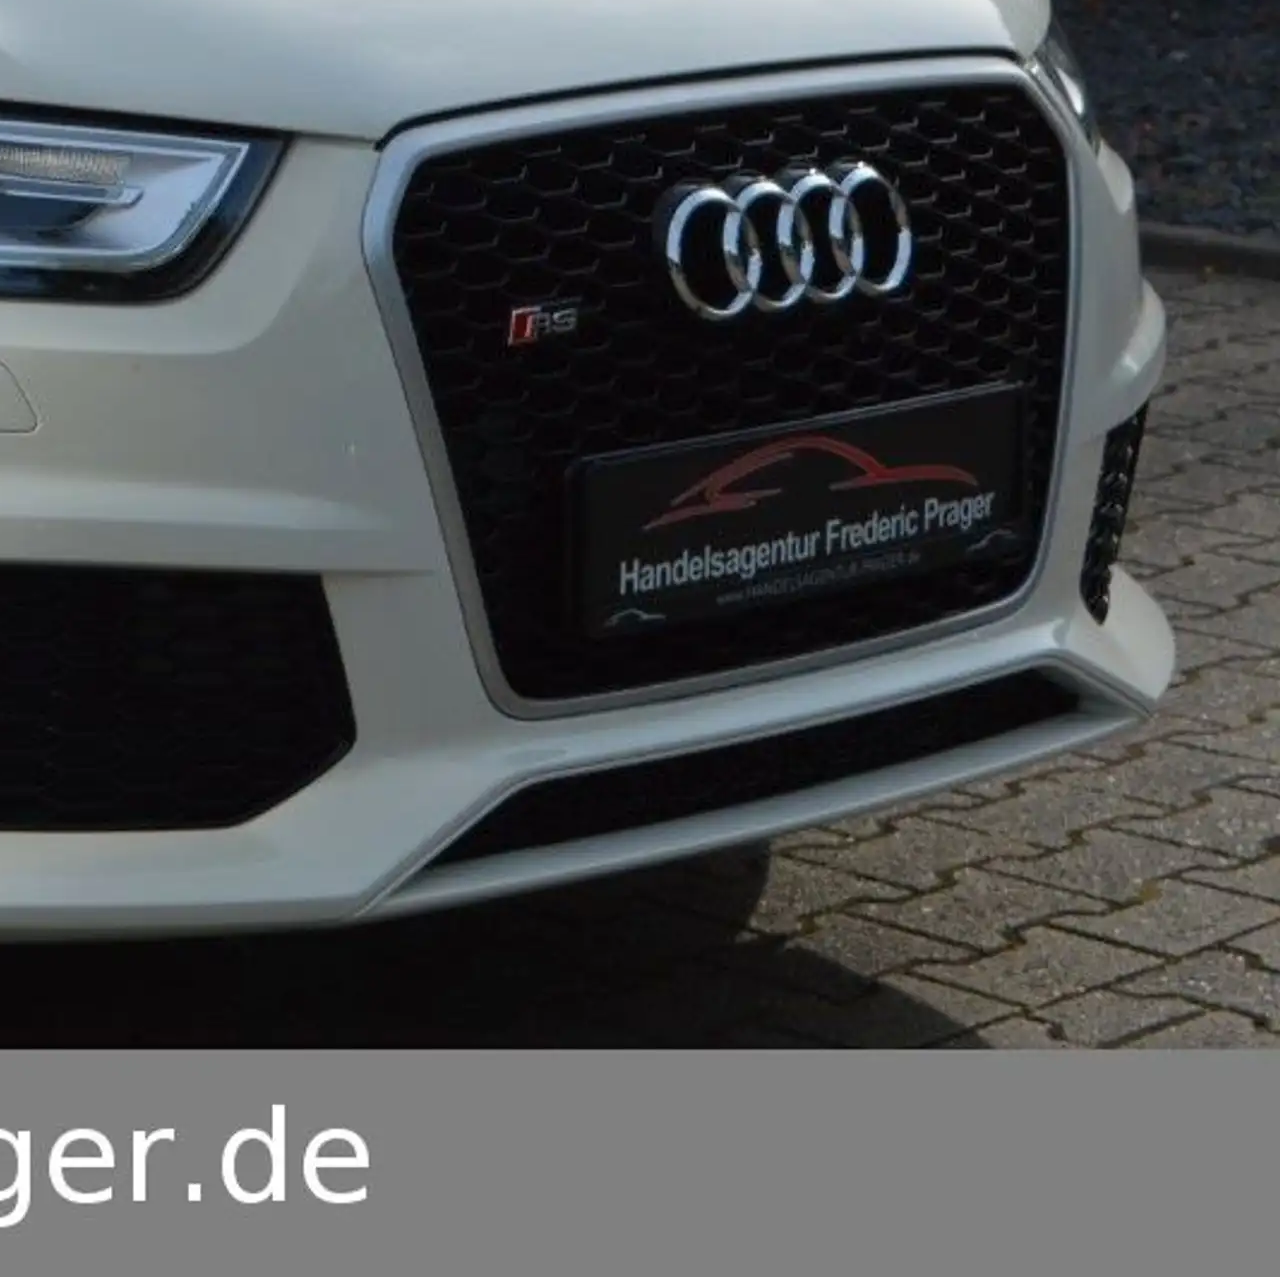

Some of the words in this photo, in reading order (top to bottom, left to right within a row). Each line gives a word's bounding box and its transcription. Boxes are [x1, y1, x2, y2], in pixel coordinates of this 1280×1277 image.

[619, 527, 821, 595] Handelsagentur
[825, 506, 920, 556] Frederic
[924, 490, 995, 532] Prager
